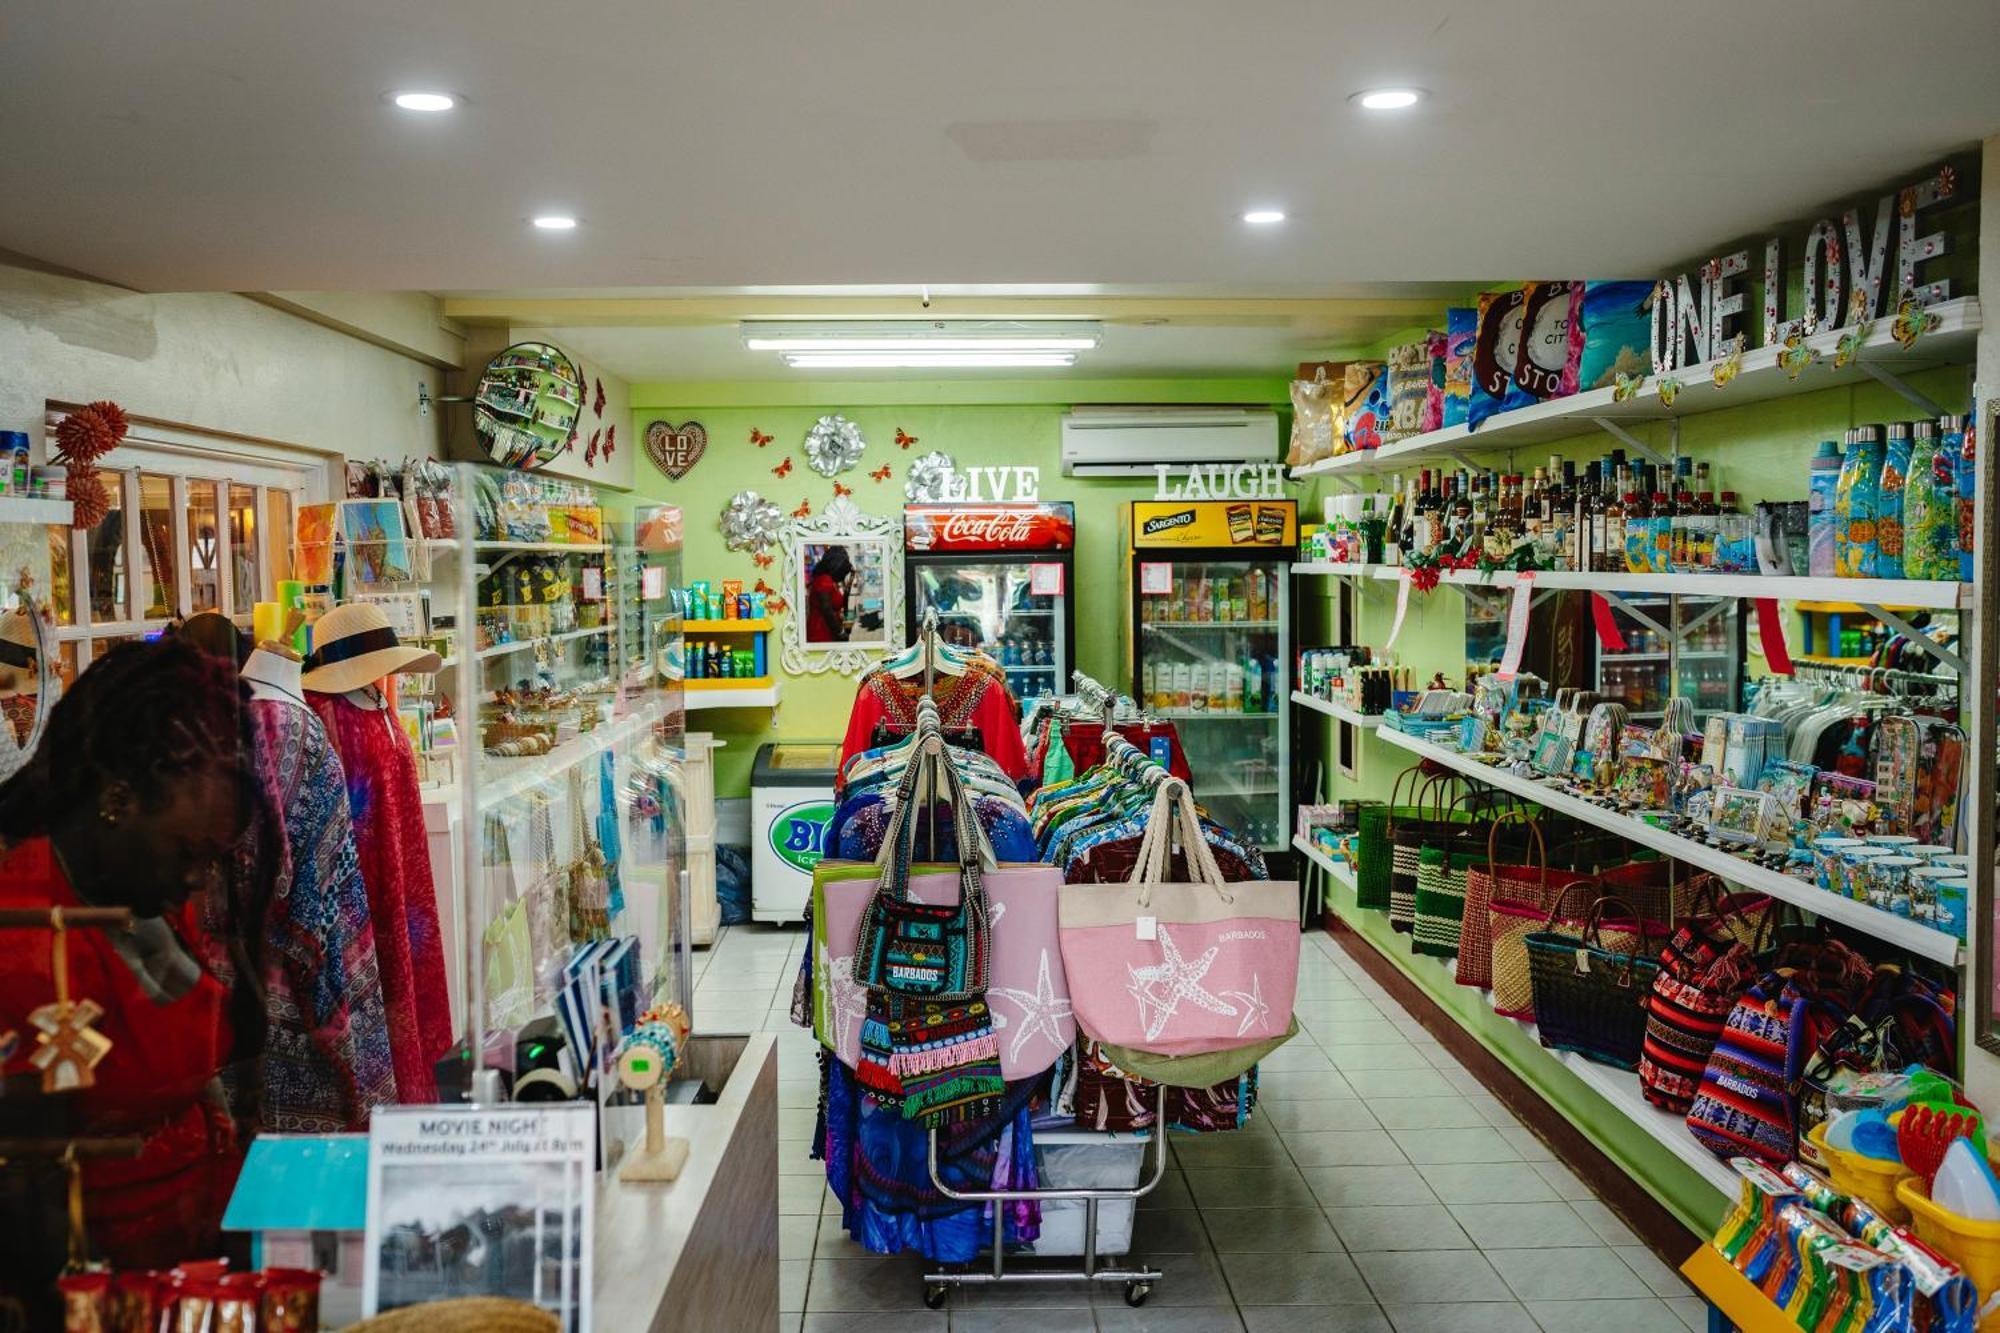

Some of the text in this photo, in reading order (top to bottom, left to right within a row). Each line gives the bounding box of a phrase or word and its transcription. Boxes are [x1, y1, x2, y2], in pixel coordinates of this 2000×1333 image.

[1651, 250, 1749, 375] ONE
[1763, 167, 1955, 346] LOVE
[1544, 334, 1568, 345] CIT
[1519, 363, 1560, 392] STO
[937, 466, 1040, 501] LIVE
[1154, 463, 1286, 500] LAUGH
[943, 512, 1037, 542] Coca-Cola
[1218, 930, 1266, 942] BARBADOS
[892, 966, 938, 982] BARBADOS
[1716, 1075, 1759, 1099] BARBADOS
[419, 1119, 481, 1136] MOVIE
[383, 1142, 466, 1156] Wednesday
[501, 1140, 530, 1154] July
